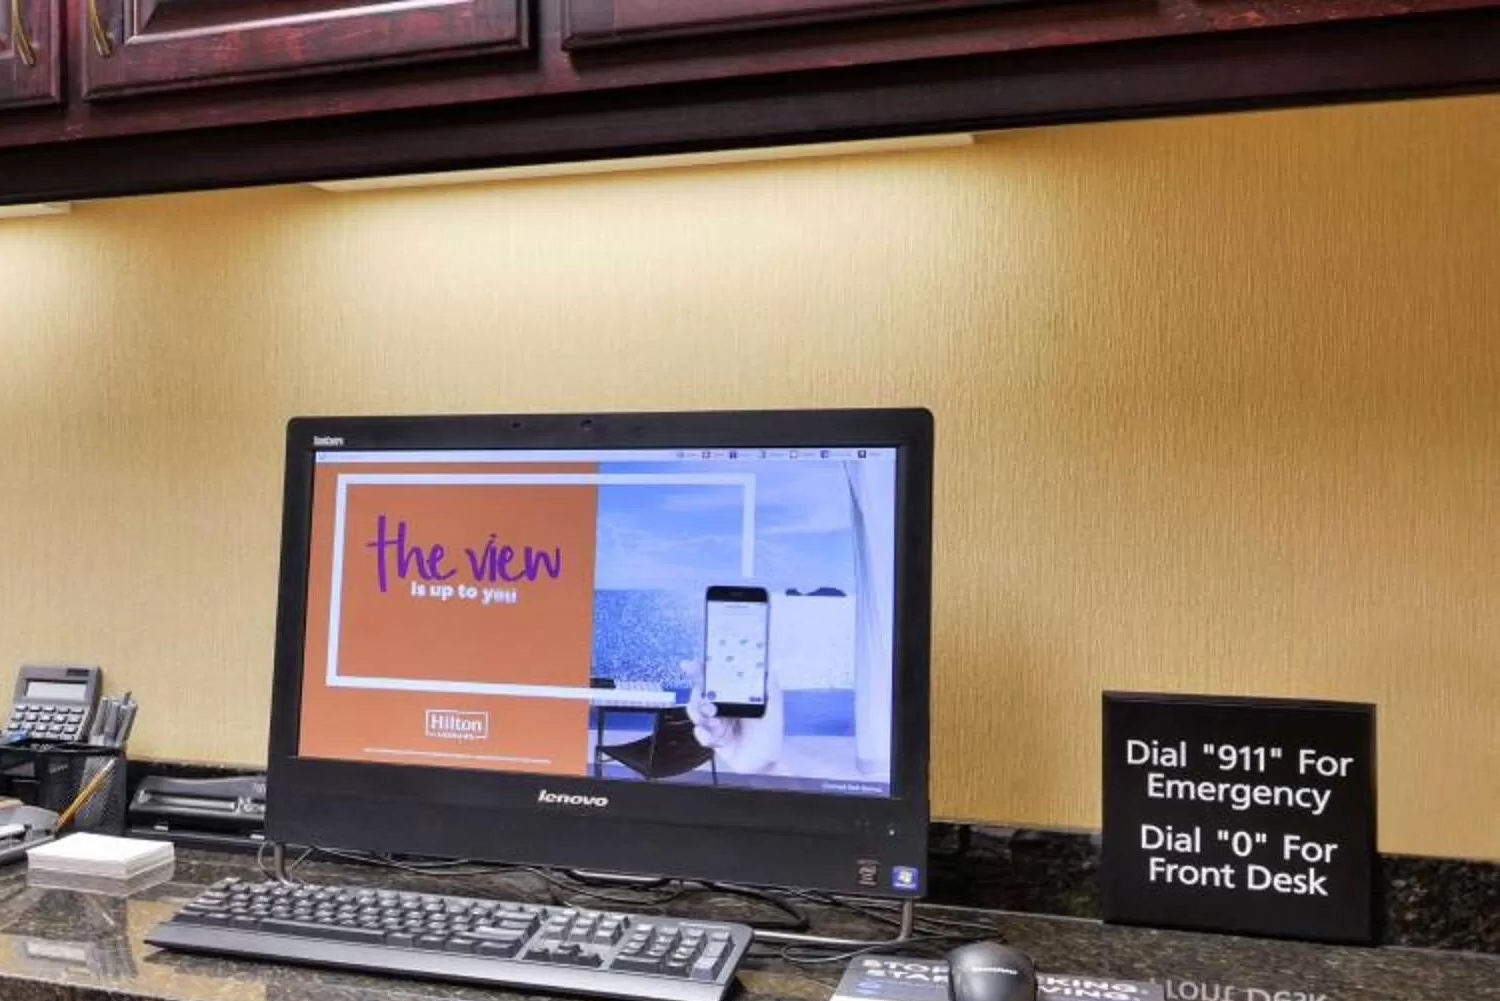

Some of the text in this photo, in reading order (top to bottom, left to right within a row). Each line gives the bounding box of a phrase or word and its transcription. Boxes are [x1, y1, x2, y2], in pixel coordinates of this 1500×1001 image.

[365, 513, 561, 593] the view
[429, 585, 453, 601] up
[458, 583, 478, 599] to
[482, 587, 517, 605] you
[431, 714, 483, 732] Hilton
[1126, 739, 1354, 777] Dial "911" For
[538, 789, 609, 807] lenovo
[1147, 772, 1332, 815] Emergency
[1141, 824, 1338, 863] Dial "0" For
[1149, 856, 1329, 896] Front Desk
